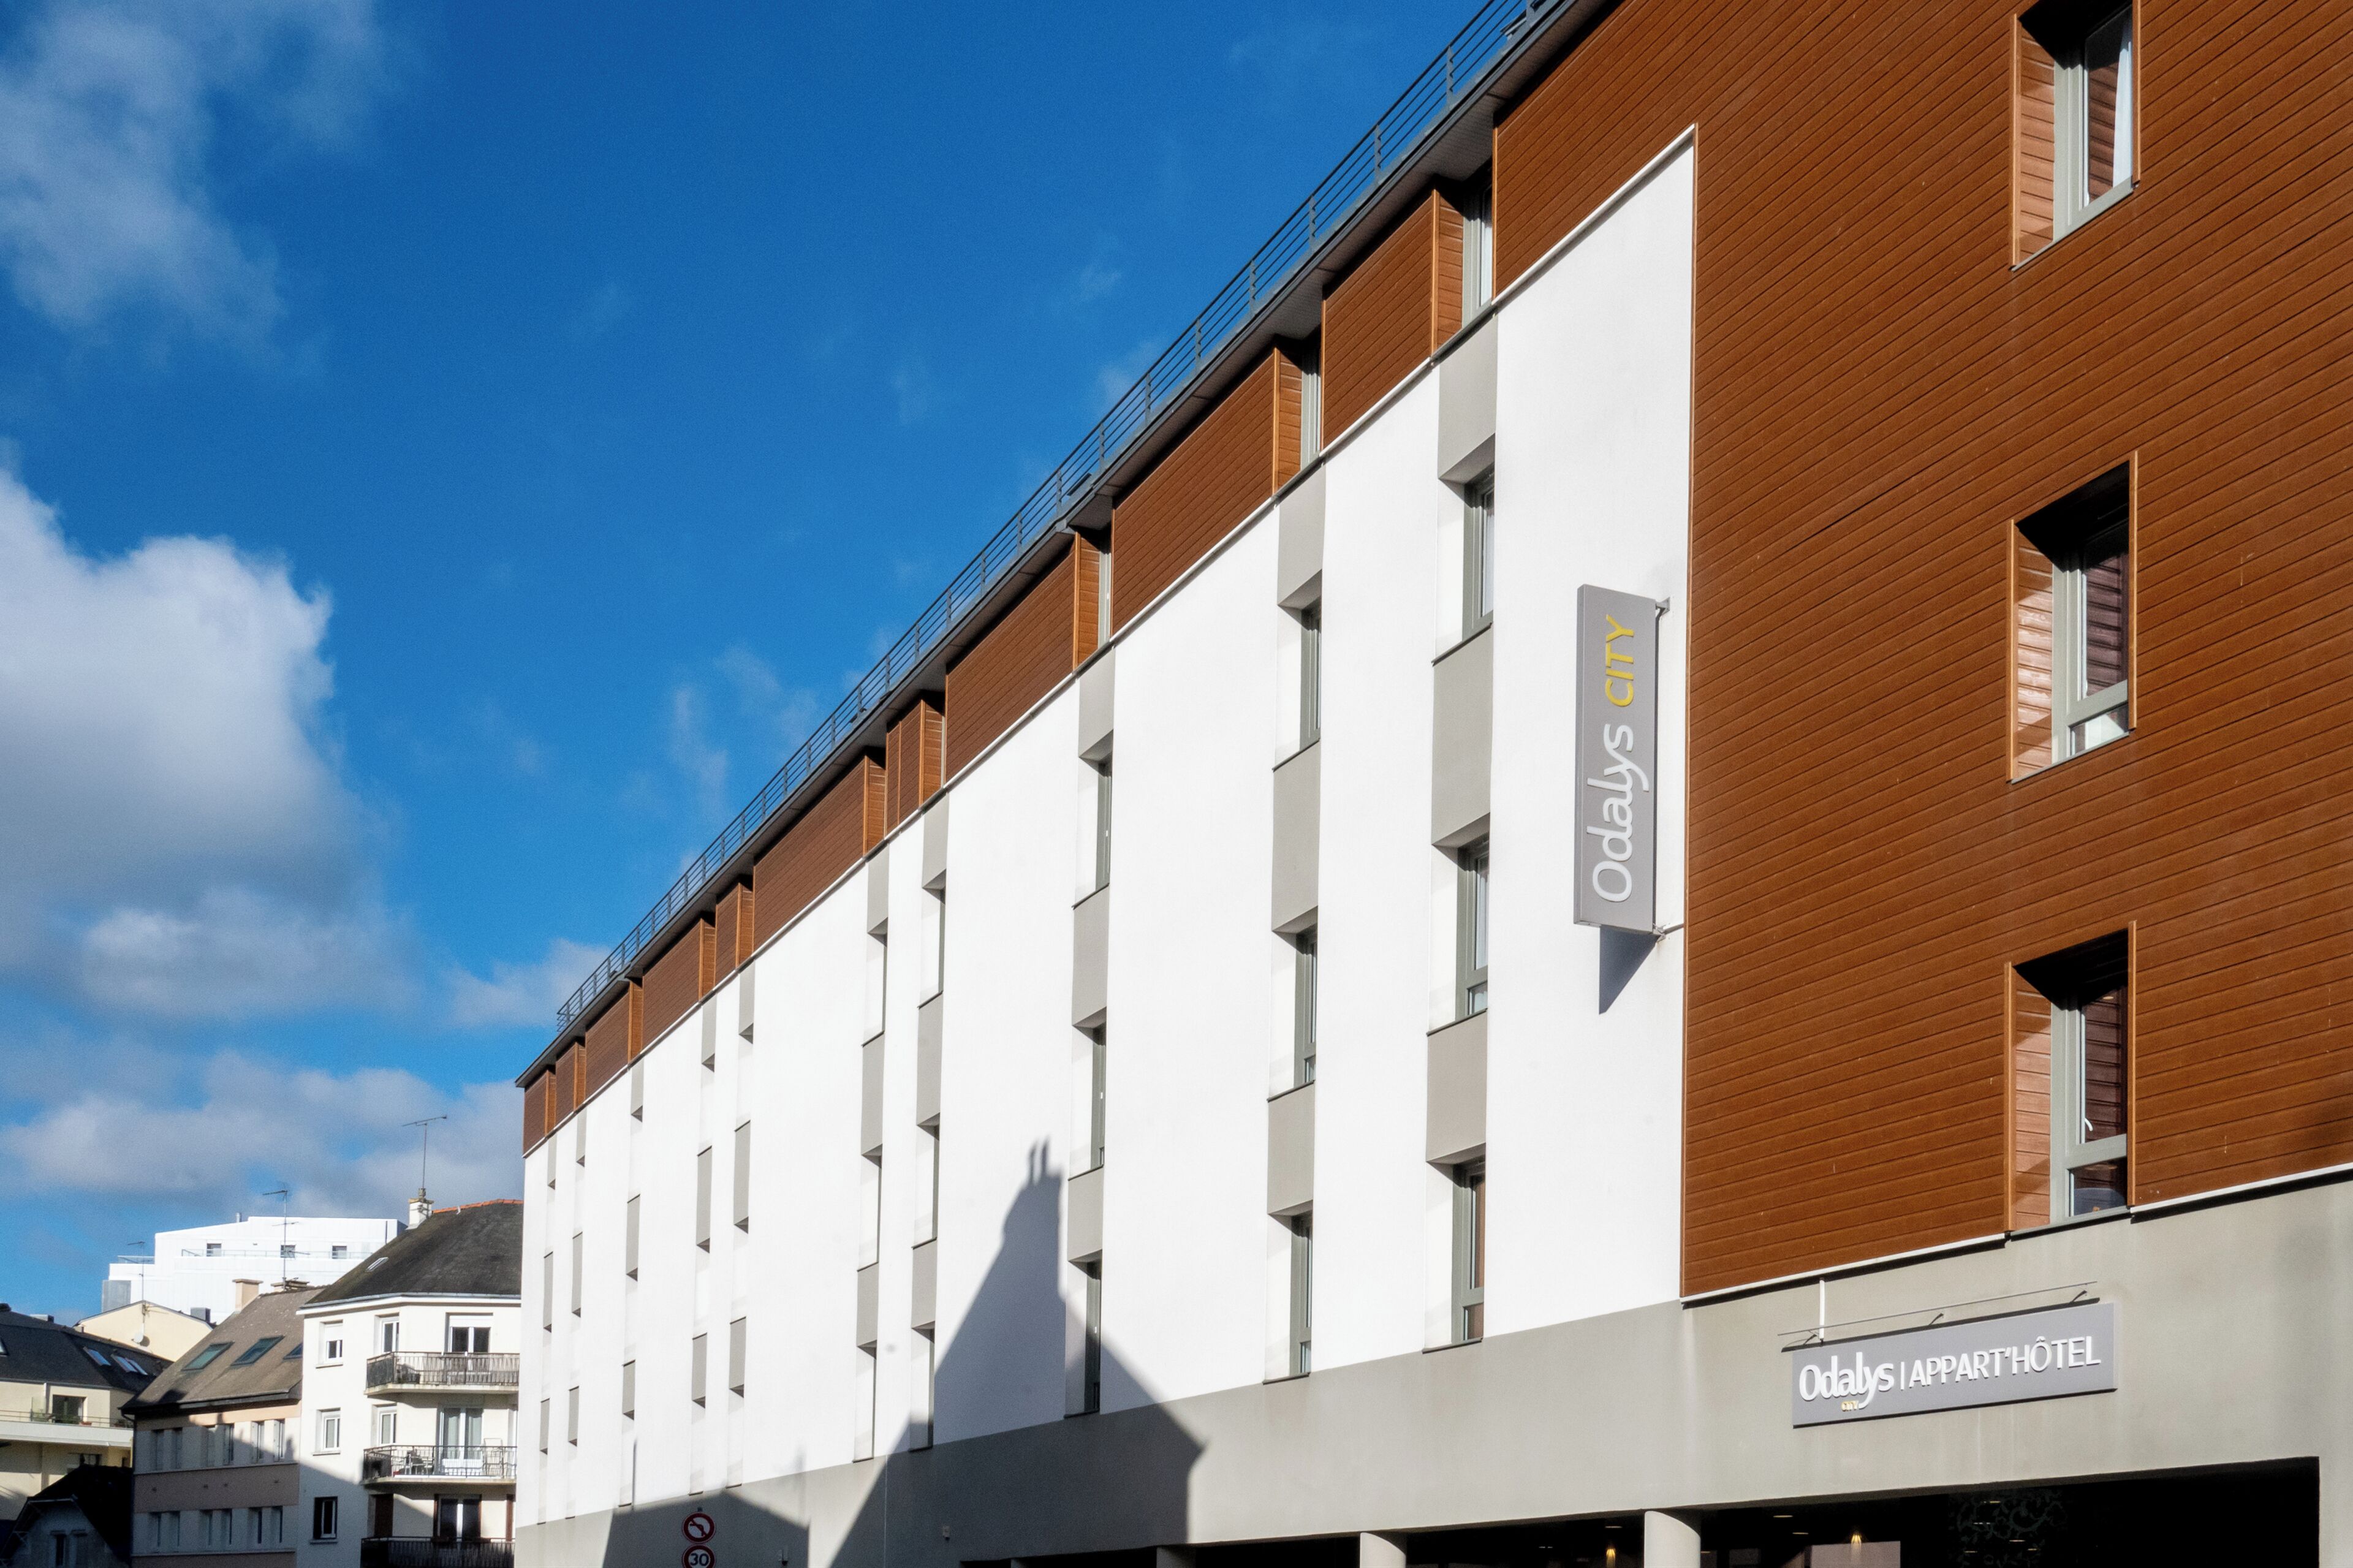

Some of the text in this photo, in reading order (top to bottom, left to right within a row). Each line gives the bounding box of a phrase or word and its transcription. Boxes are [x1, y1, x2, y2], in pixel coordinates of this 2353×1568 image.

[1586, 614, 1650, 903] Odalys CITY
[1799, 1351, 1895, 1409] Odalys
[690, 1553, 710, 1566] 30
